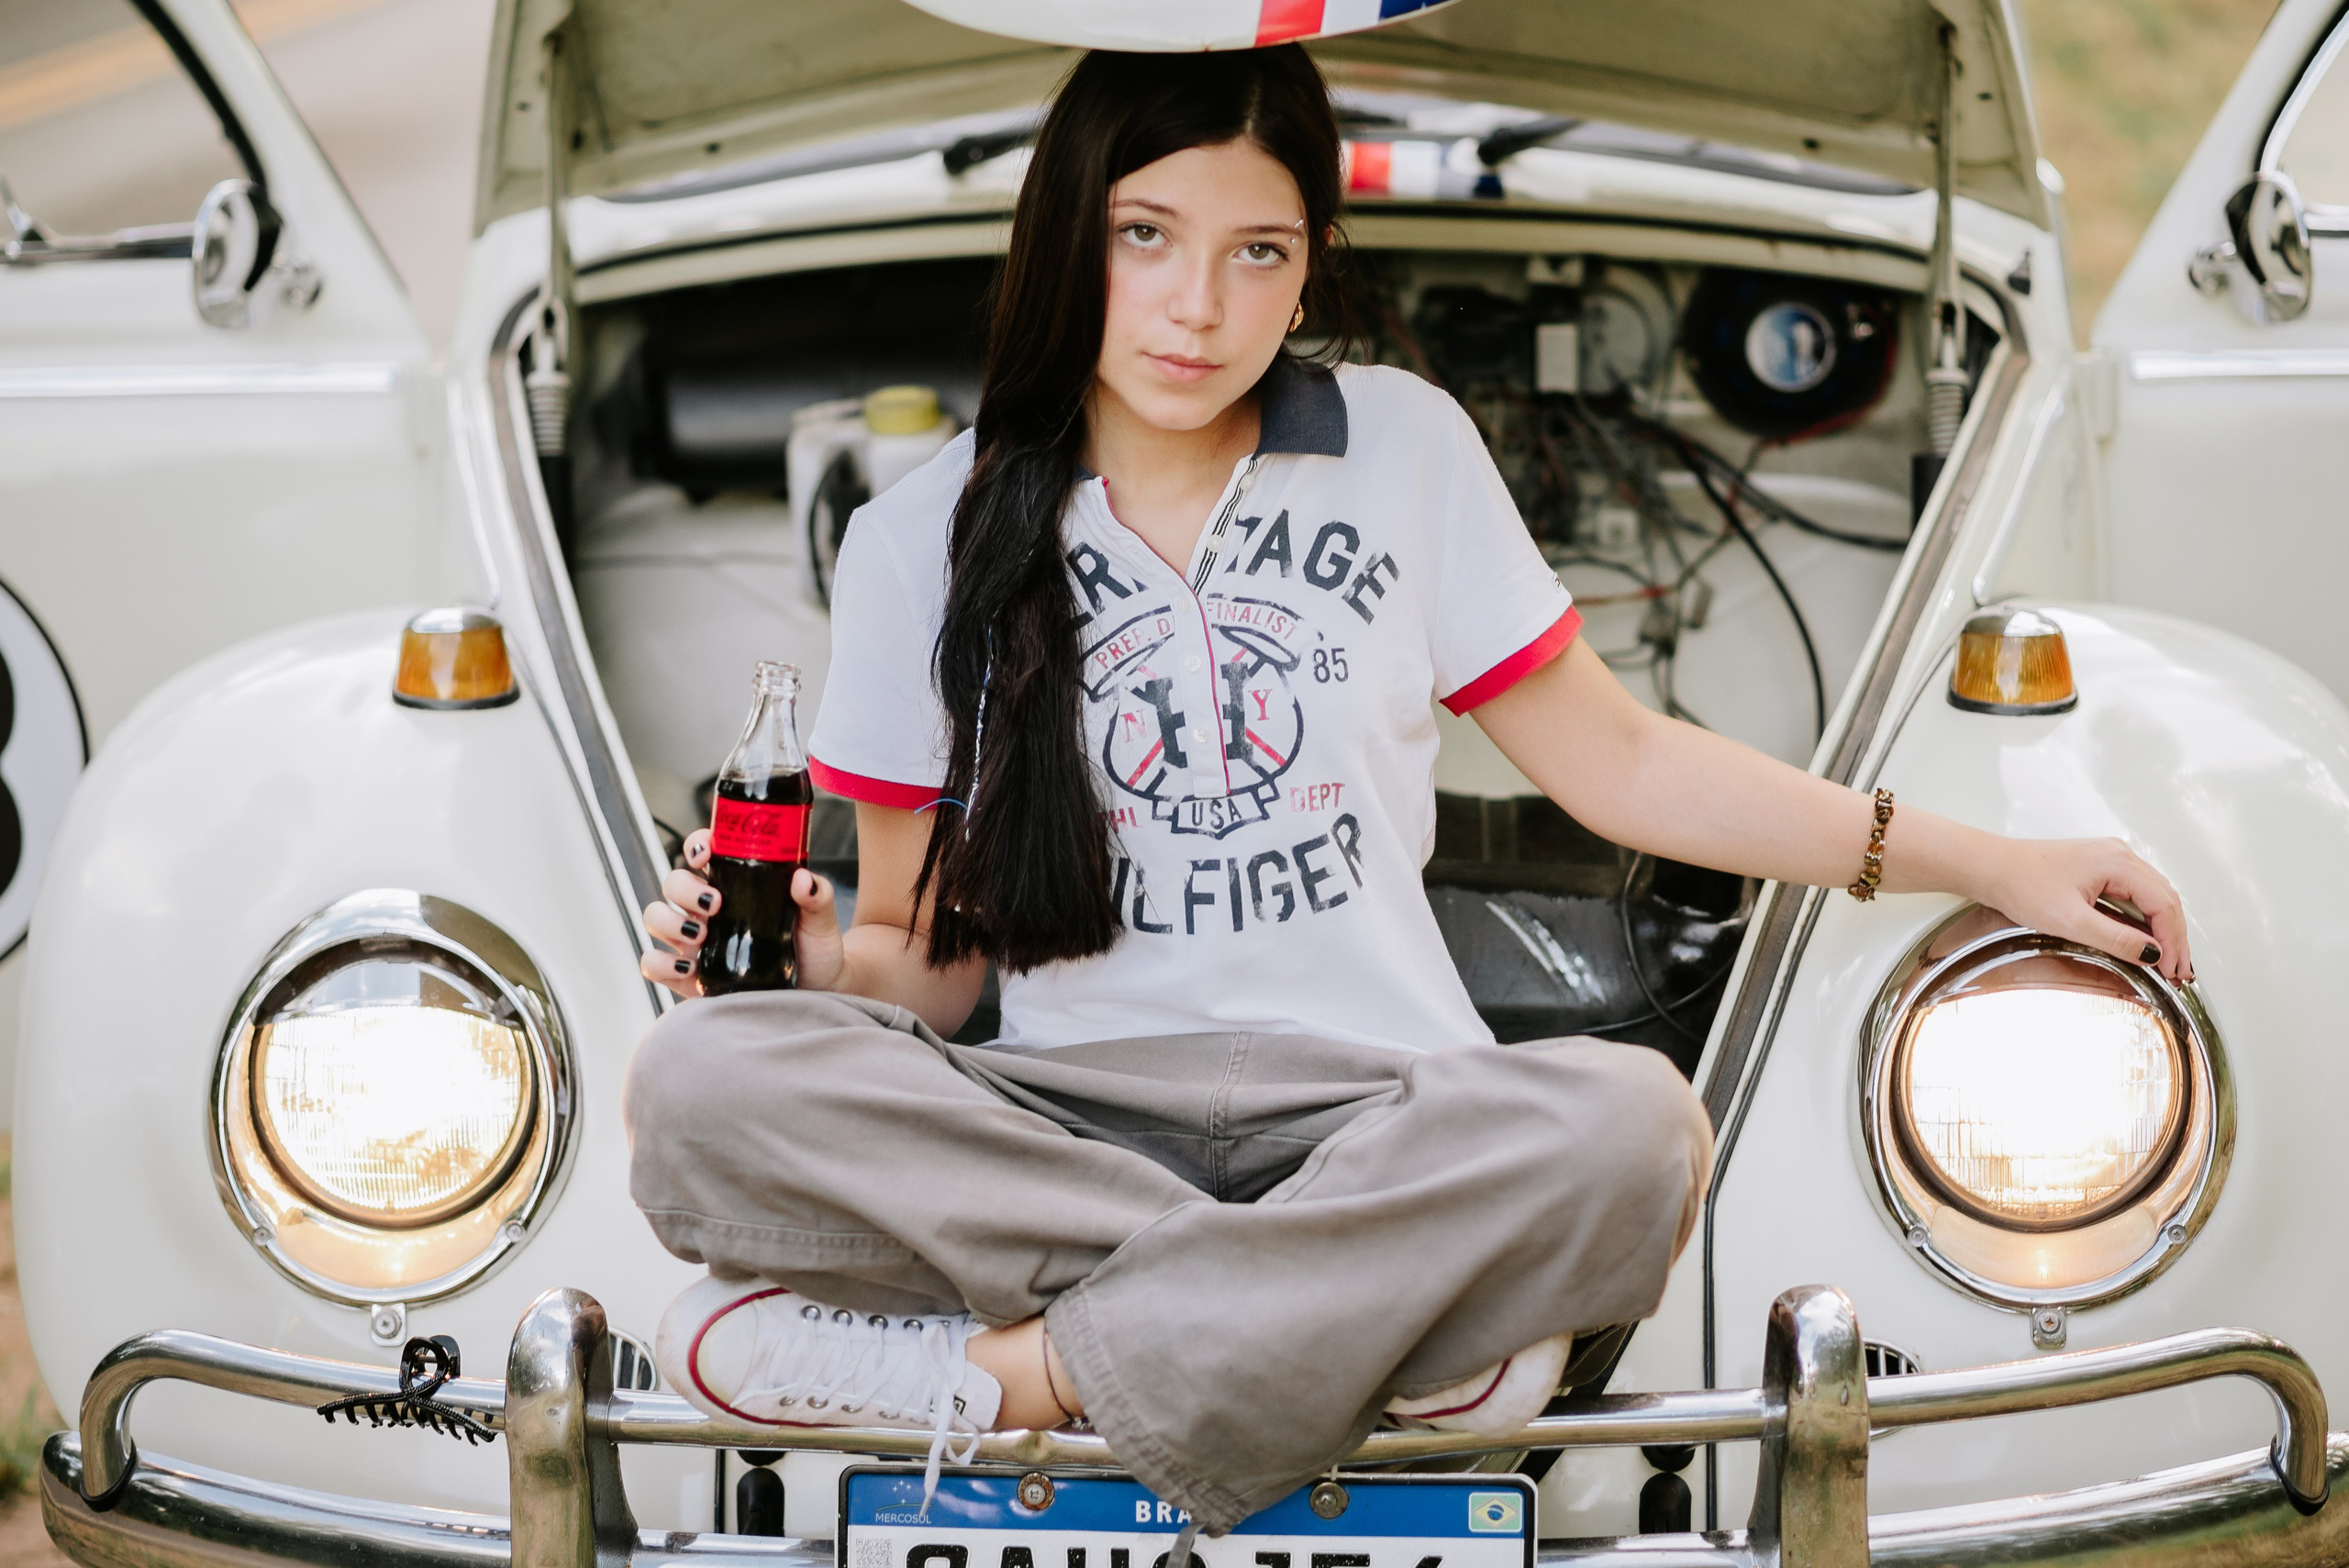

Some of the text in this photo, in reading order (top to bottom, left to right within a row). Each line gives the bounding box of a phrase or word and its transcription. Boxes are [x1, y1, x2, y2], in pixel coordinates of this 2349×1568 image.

[1120, 688, 1274, 743] N Y
[1191, 797, 1242, 829] USA
[1289, 782, 1346, 813] DEPT
[1110, 813, 1364, 936] ILFIGER
[875, 1512, 932, 1524] MERCOSUL
[1135, 1499, 1193, 1524] BRA
